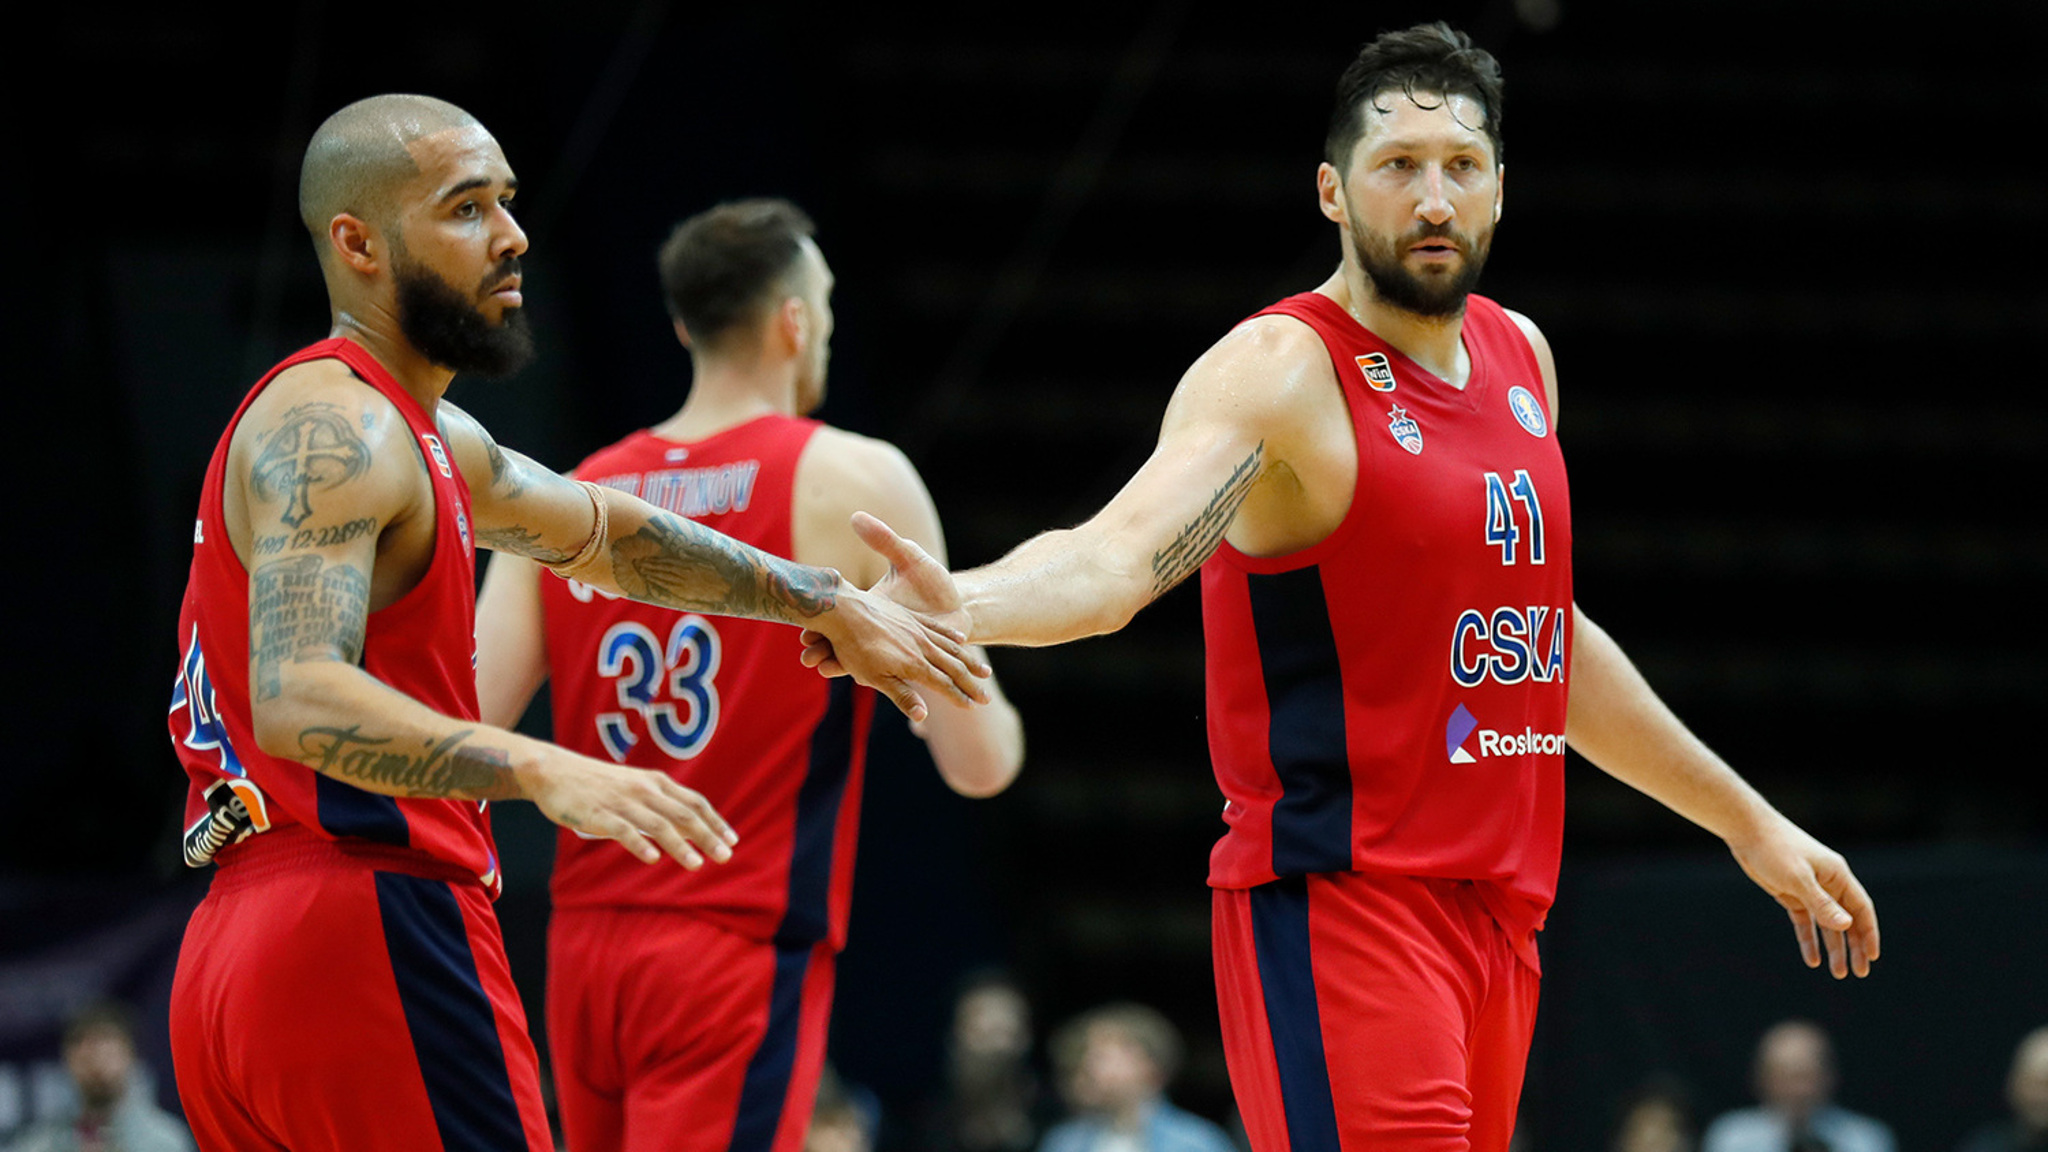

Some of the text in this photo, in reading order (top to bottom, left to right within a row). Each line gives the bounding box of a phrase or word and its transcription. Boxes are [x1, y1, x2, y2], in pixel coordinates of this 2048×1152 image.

[1484, 469, 1545, 566] 41
[595, 614, 722, 765] 33
[1450, 606, 1565, 689] CSKA
